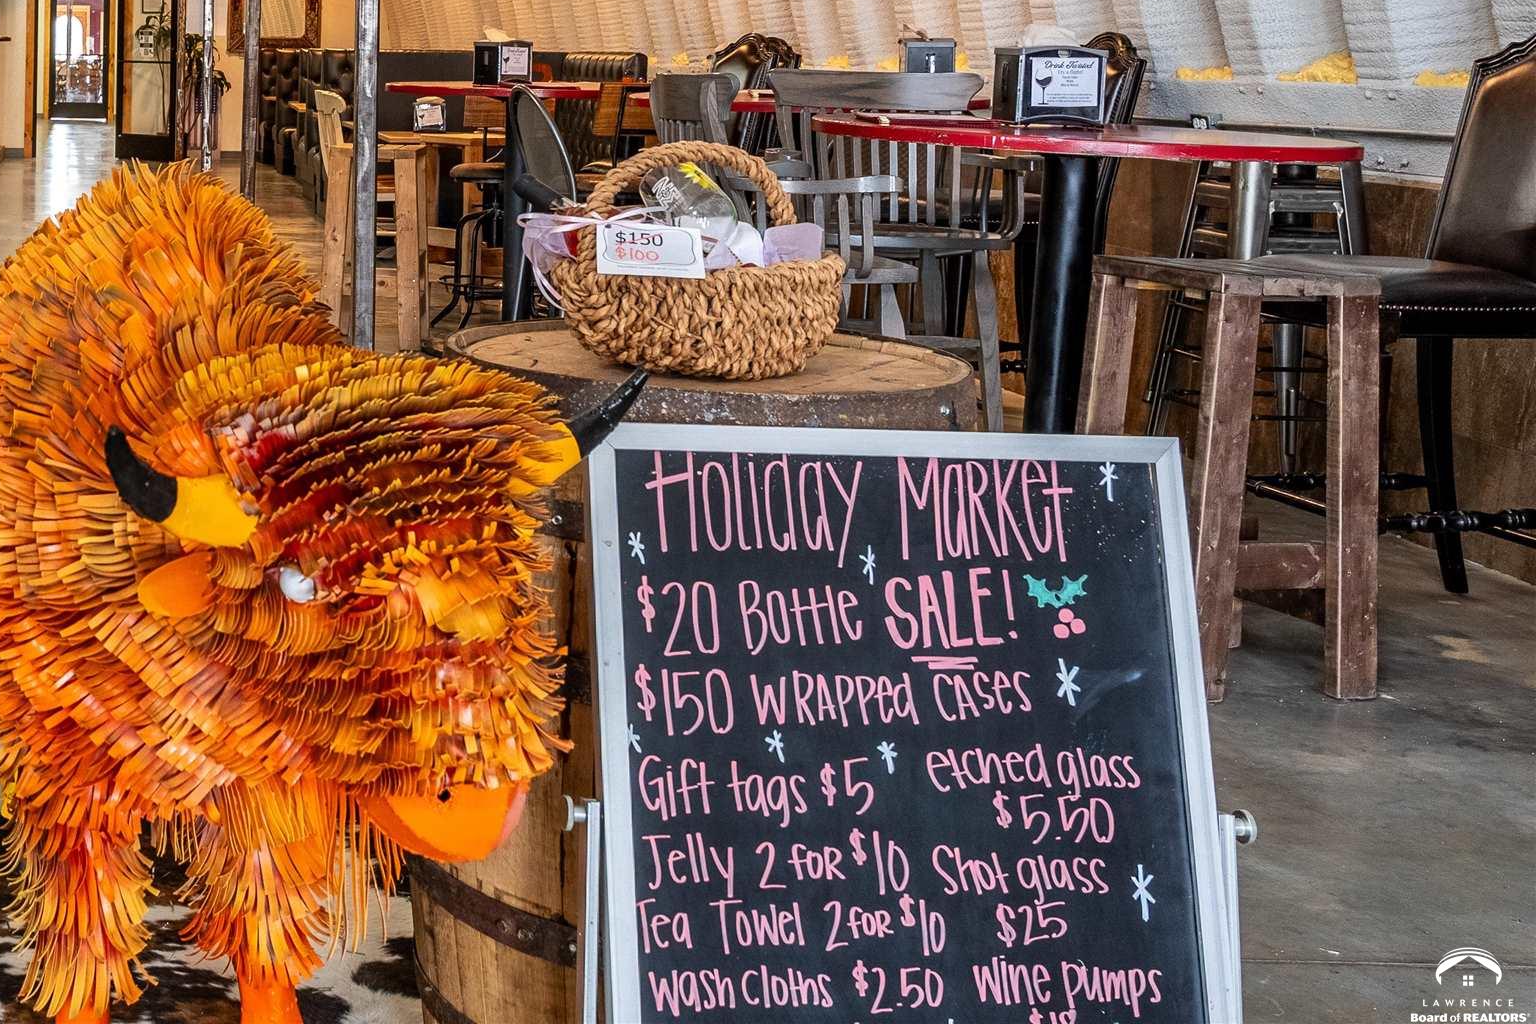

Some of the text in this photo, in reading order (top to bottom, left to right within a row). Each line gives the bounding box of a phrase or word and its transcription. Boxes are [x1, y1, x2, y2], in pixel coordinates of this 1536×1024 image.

[615, 230, 663, 247] $150
[615, 245, 660, 261] $100
[645, 451, 862, 568] Holiday
[635, 567, 1017, 658] $20 Bottle SALE!
[633, 664, 737, 737] $150
[638, 755, 875, 828] Gift tags $5
[925, 744, 1142, 798] etched glass
[991, 791, 1117, 844] $5.50
[641, 831, 737, 897] Jelly
[754, 841, 787, 890] 2
[848, 827, 911, 897] $10
[931, 843, 1110, 905] Shot glass
[637, 899, 693, 953] Tea
[711, 899, 805, 954] Towel
[824, 900, 850, 951] 2
[899, 894, 946, 957] $10
[994, 902, 1069, 948] $25
[851, 961, 947, 1014] $2.50
[1060, 961, 1162, 1018] pumps
